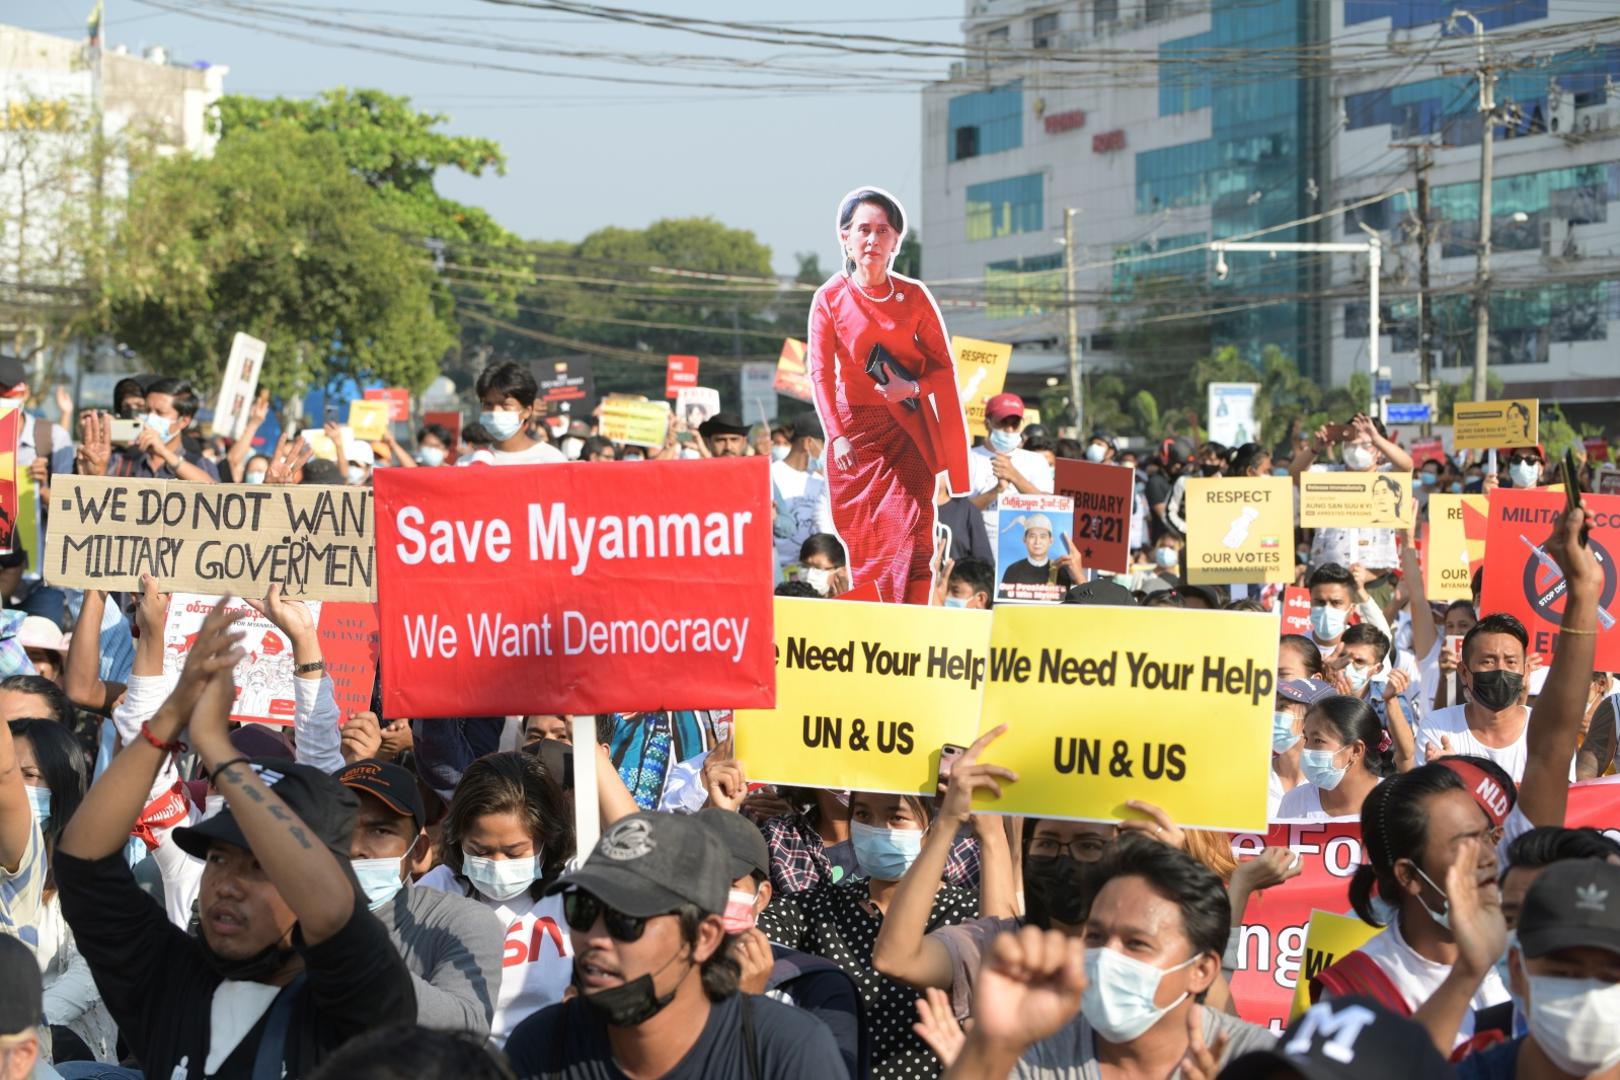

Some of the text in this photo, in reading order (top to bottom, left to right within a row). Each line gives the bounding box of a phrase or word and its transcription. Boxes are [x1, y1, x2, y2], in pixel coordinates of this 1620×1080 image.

[961, 349, 998, 364] RESPECT
[74, 486, 374, 537] WE DO NOT WAN
[1206, 490, 1271, 503] RESPECT
[1448, 508, 1462, 519] RE
[1502, 507, 1561, 524] MILITA
[395, 502, 752, 576] Save Myanmar
[1080, 513, 1123, 543] 2021
[61, 535, 184, 577] MILITARY
[1202, 551, 1280, 563] OUR VOTES
[1245, 565, 1280, 573] CITIZENS
[1441, 569, 1467, 579] OUR
[1538, 590, 1554, 607] STOP
[403, 613, 457, 659] We
[467, 611, 553, 658] Want
[563, 610, 749, 663] Democracy
[786, 636, 855, 673] Need
[861, 641, 921, 676] Your
[926, 646, 986, 690] Help
[990, 647, 1273, 706] We Need Your Help
[803, 715, 914, 755] UN & US
[1054, 737, 1186, 782] UN & US
[1475, 777, 1508, 817] NLD
[1289, 823, 1372, 877] Fo
[502, 916, 567, 968] SA
[1238, 921, 1309, 989] ng
[1305, 947, 1334, 981] W
[1285, 1002, 1376, 1062] M
